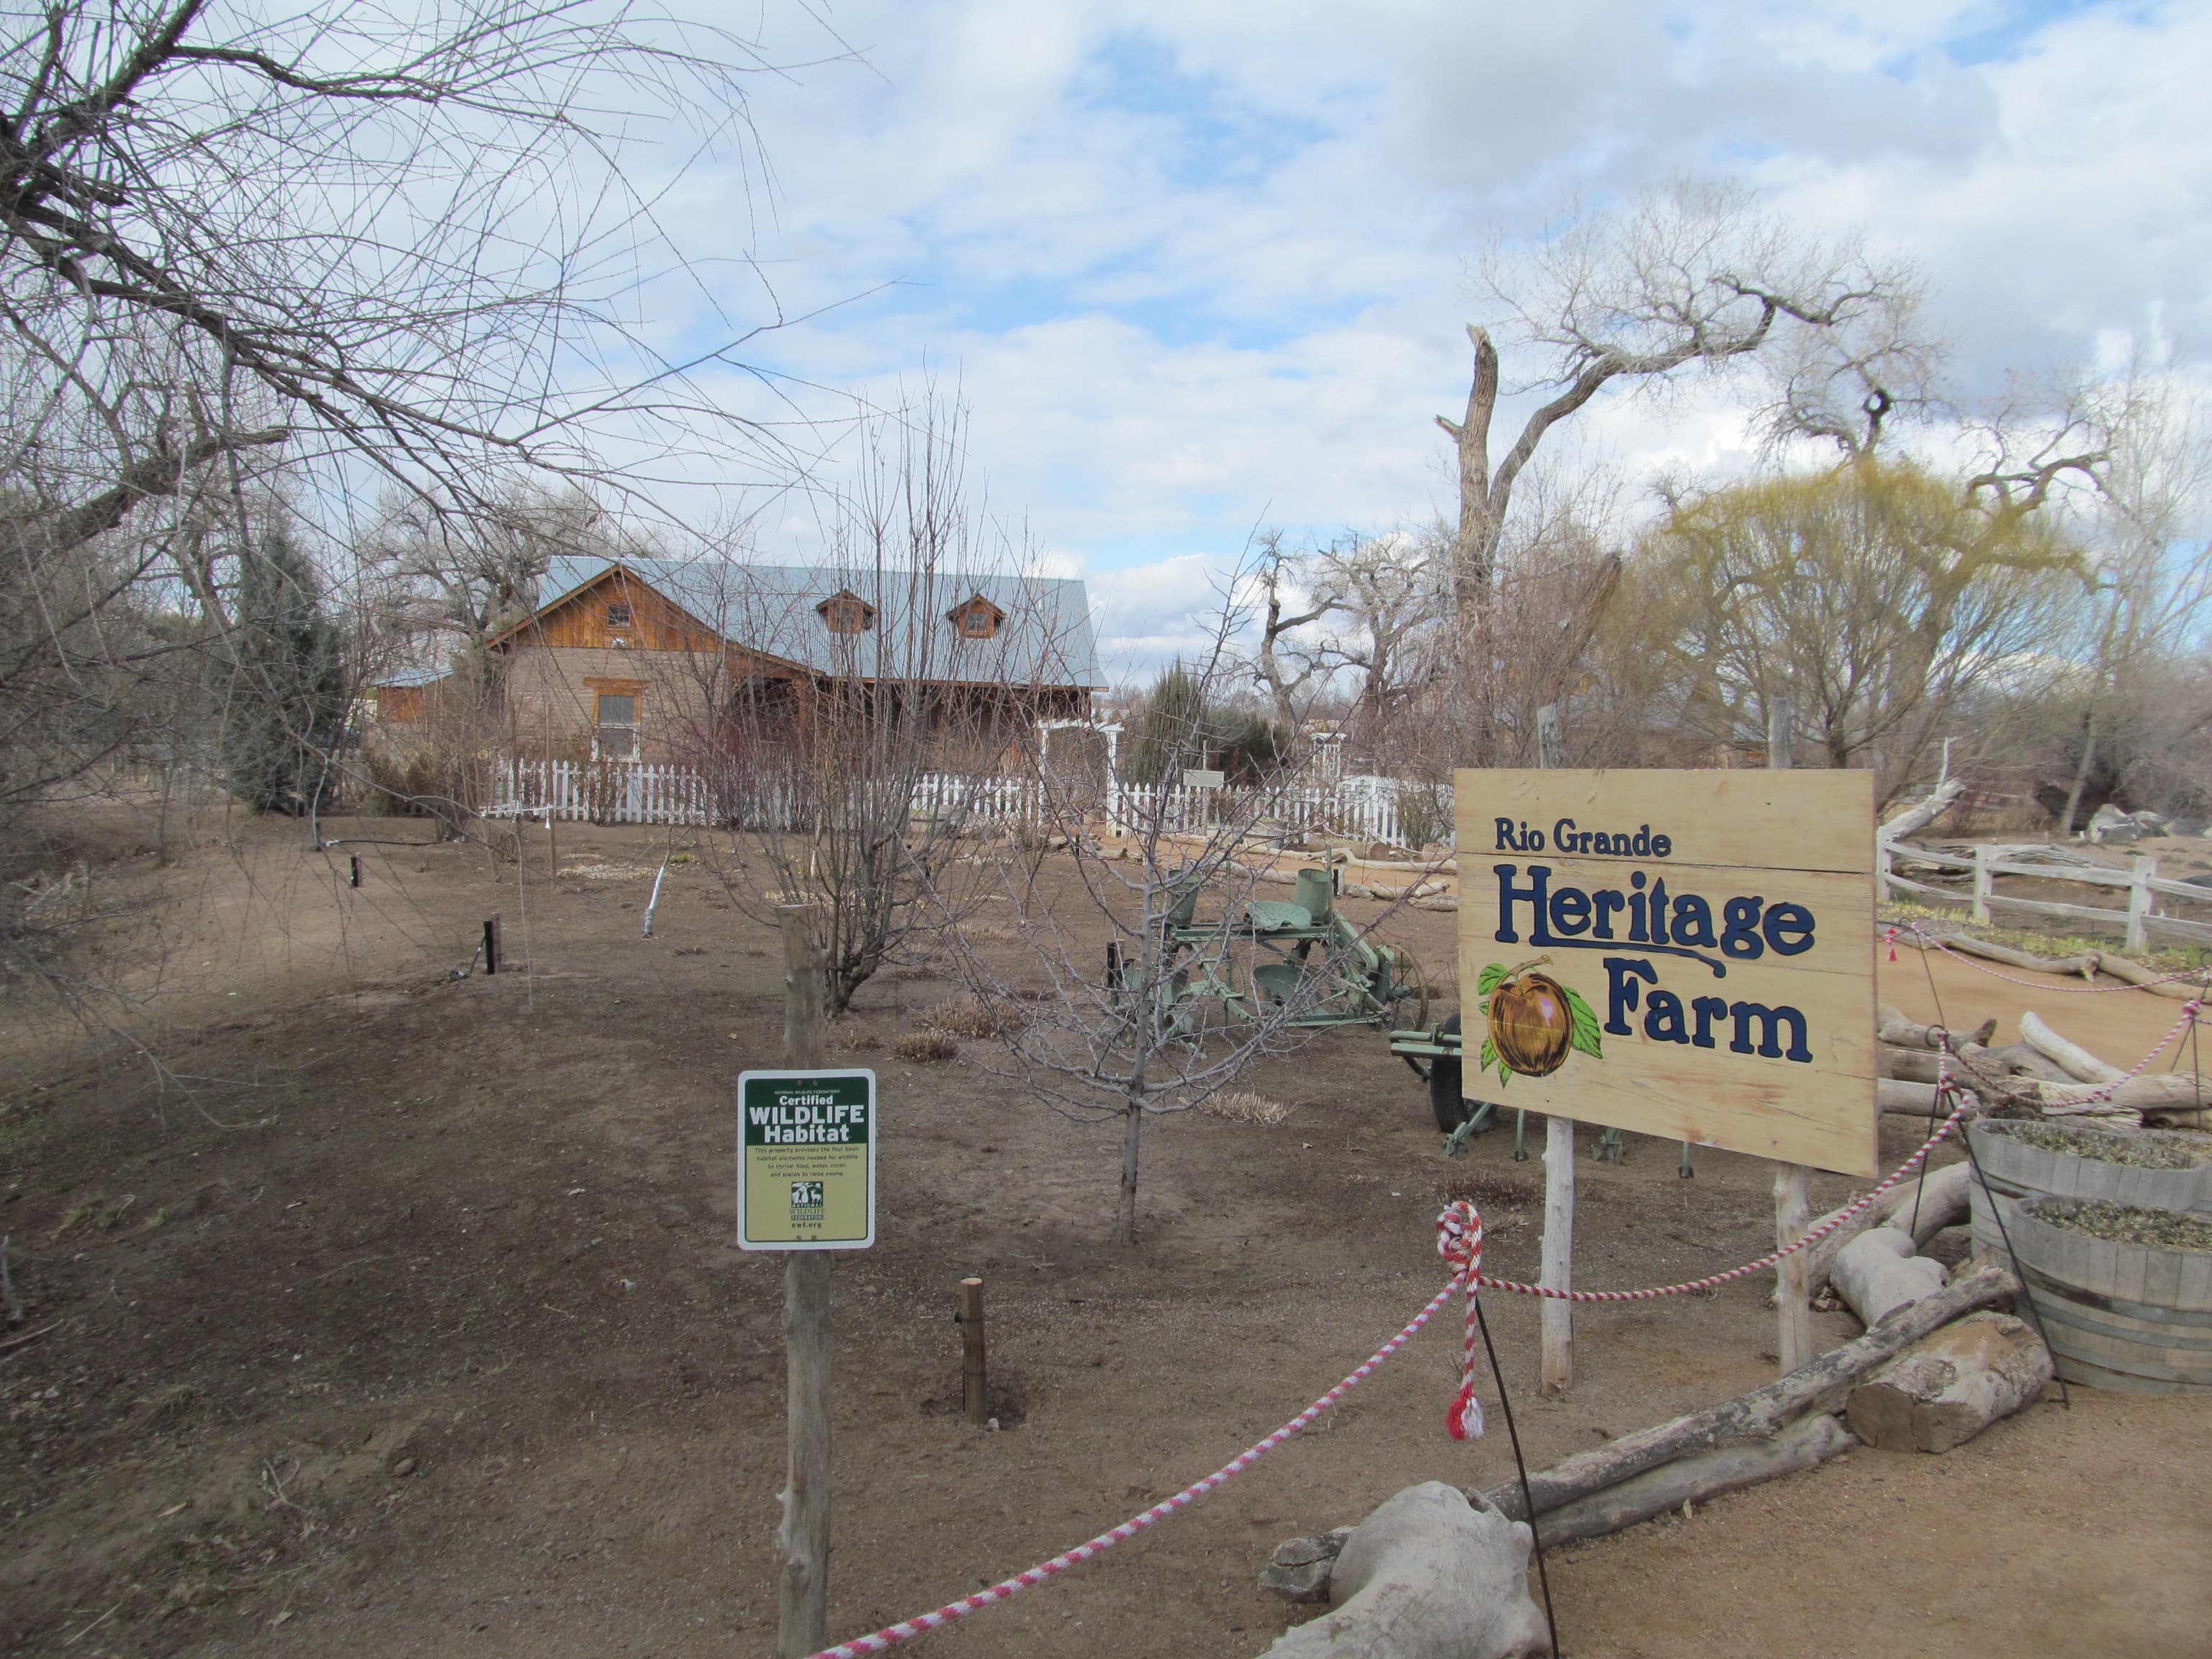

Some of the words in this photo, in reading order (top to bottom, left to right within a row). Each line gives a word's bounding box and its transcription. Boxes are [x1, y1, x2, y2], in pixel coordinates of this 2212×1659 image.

[1493, 817, 1545, 852] Rio
[1553, 818, 1672, 858] Grande
[1493, 863, 1816, 968] Heritage
[1603, 957, 1814, 1064] Farm
[779, 1094, 833, 1105] Certified
[749, 1105, 865, 1125] WILDLIFE
[764, 1123, 850, 1143] Habitat
